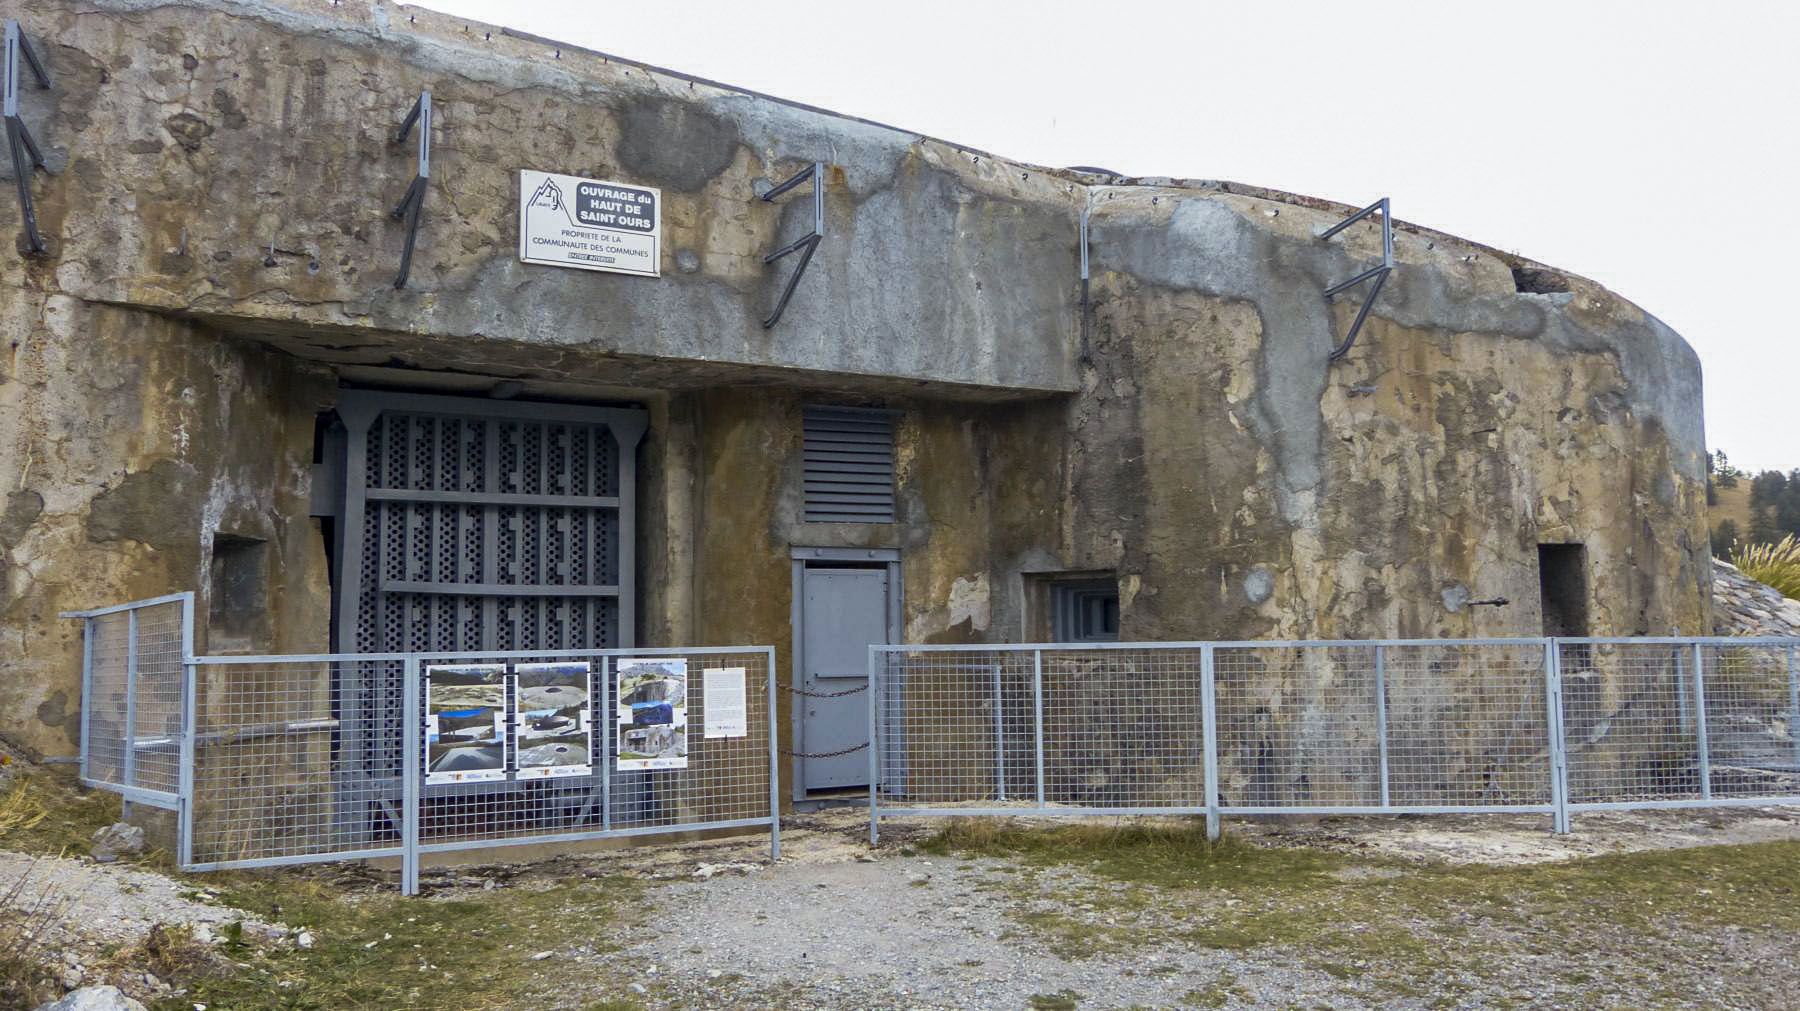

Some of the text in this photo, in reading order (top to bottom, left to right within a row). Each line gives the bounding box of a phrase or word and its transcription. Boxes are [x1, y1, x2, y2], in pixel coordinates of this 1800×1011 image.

[580, 186, 652, 204] OUVRAGE du
[590, 199, 641, 215] HAUT DE
[580, 211, 651, 229] SAINT OURS
[532, 237, 649, 258] COMMUNAUTE DES COMMUNES
[600, 234, 610, 242] DE
[612, 235, 622, 243] LA
